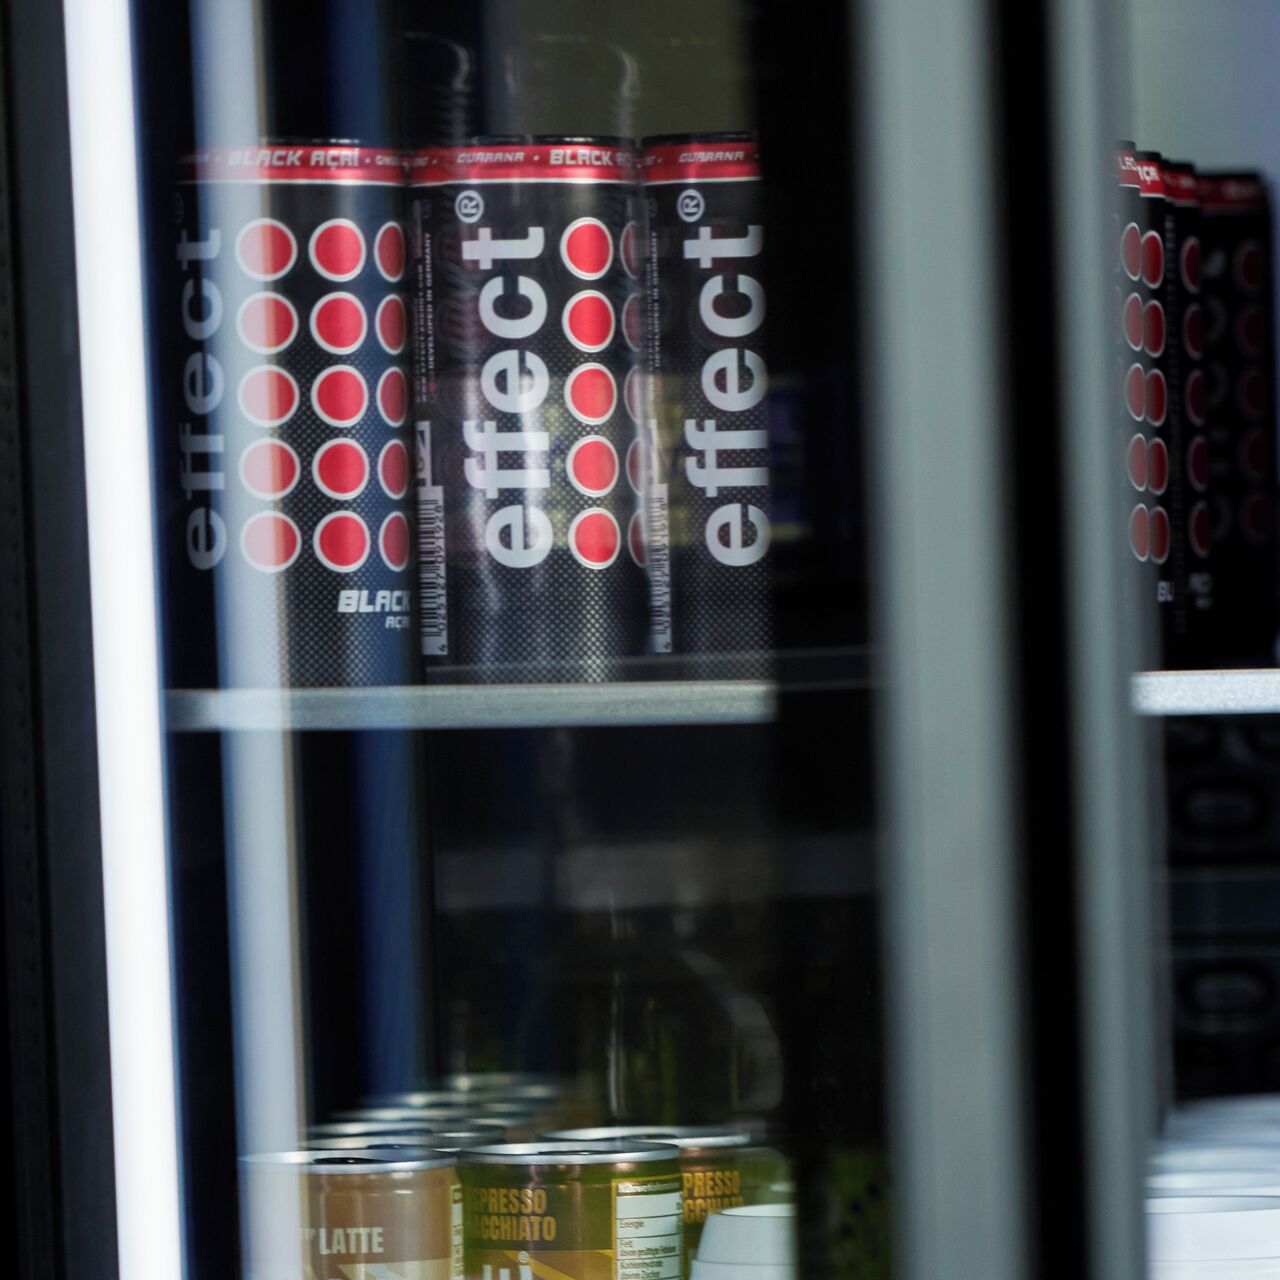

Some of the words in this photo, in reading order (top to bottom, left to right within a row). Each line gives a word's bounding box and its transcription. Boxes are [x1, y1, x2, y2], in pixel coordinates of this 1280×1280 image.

[227, 148, 304, 167] BLACK
[549, 149, 613, 166] BLACK
[682, 1170, 740, 1198] PRESSO
[318, 1226, 385, 1255] LATTE
